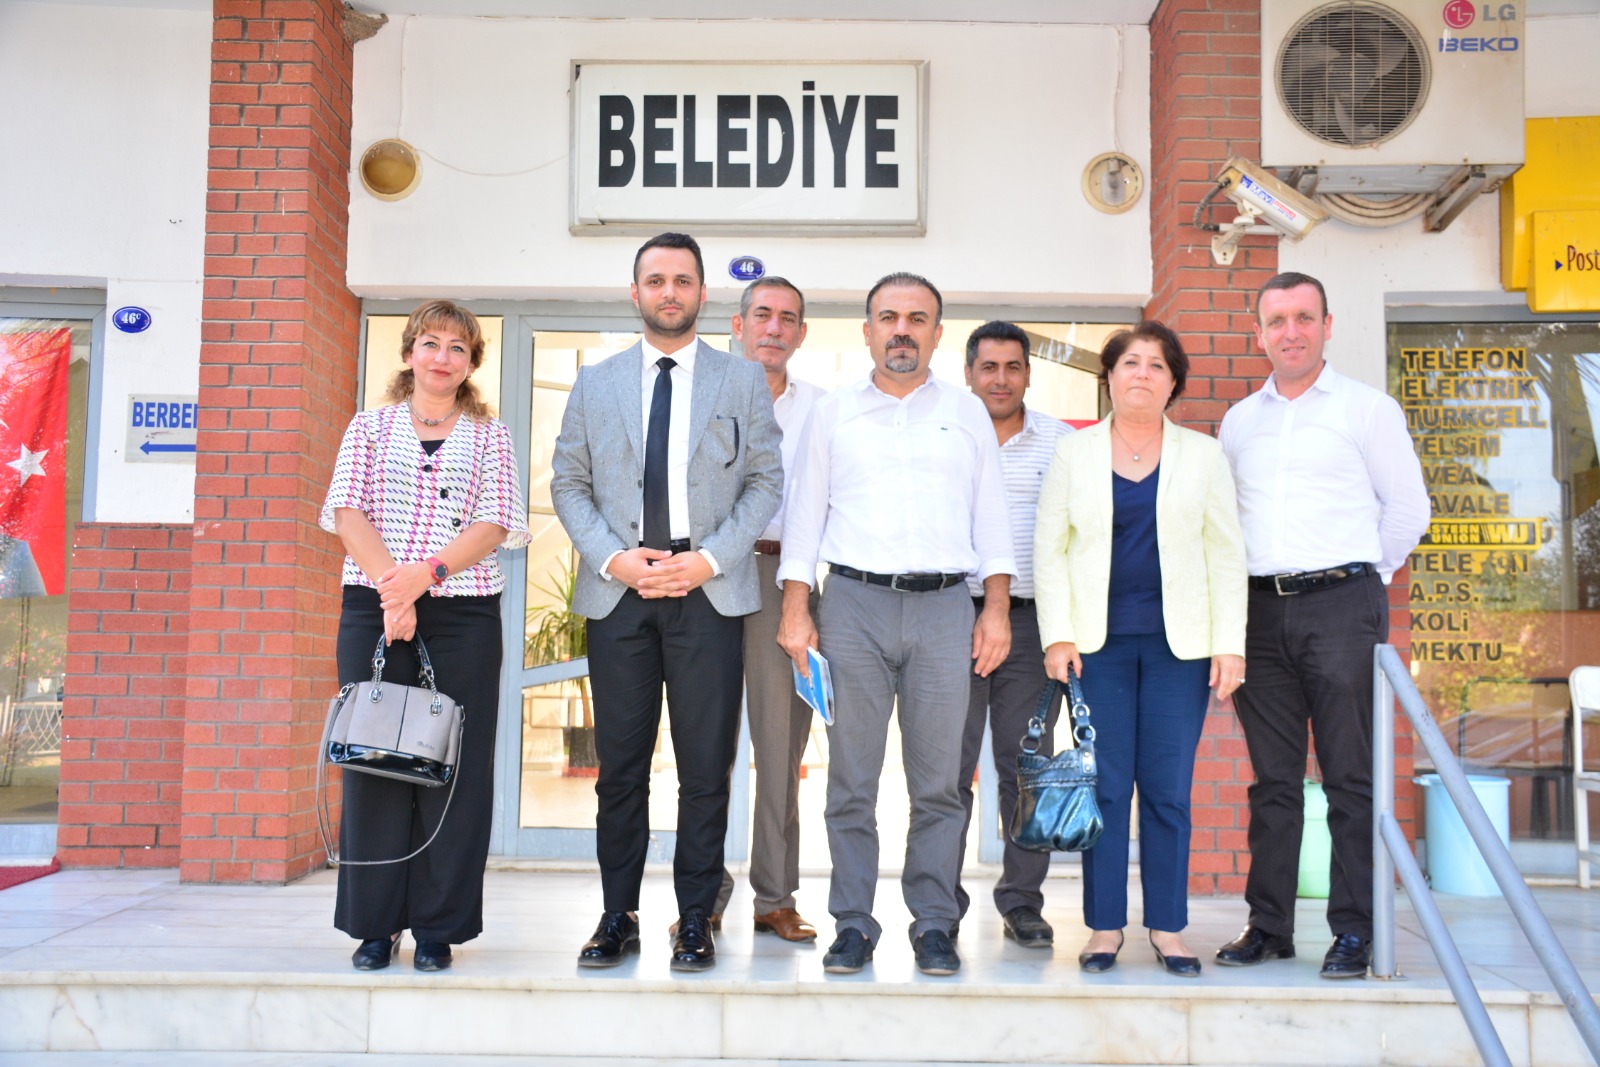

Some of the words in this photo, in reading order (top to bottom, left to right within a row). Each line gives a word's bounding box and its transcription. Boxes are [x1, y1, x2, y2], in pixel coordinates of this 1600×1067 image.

[1483, 4, 1516, 21] LG
[1438, 37, 1519, 52] BEKO
[598, 80, 899, 188] BELEDİYE
[740, 261, 755, 273] 46
[1402, 349, 1526, 371] TELEFON
[1403, 407, 1547, 428] TURKCELL
[1423, 465, 1476, 486] VEA
[1430, 493, 1509, 514] AVALE
[1428, 524, 1480, 534] STERN
[1431, 534, 1480, 543] UNION
[1410, 582, 1479, 602] A.P.S.
[1410, 642, 1503, 662] MEKTU
